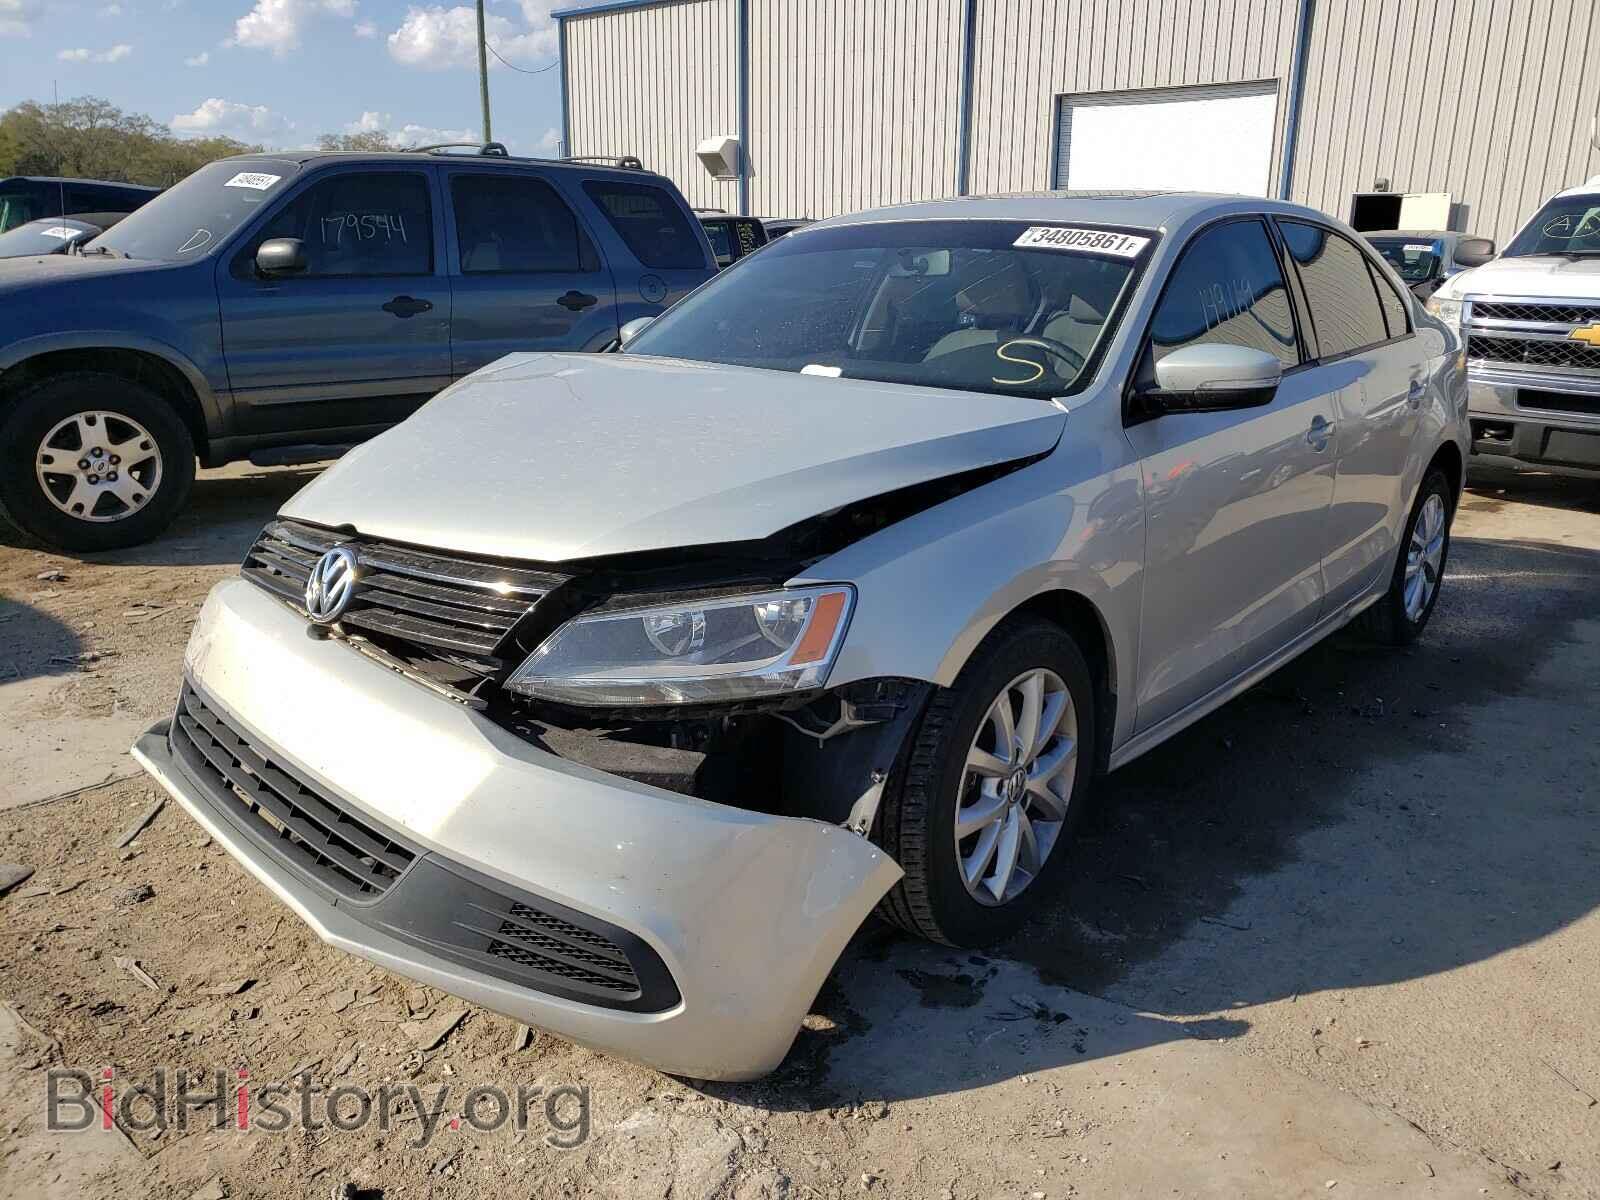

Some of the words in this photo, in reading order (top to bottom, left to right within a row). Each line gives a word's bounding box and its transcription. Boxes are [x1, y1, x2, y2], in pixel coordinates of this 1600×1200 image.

[178, 228, 212, 252] D
[321, 214, 407, 243] 179544
[1033, 228, 1129, 251] 34805861
[992, 339, 1050, 384] S
